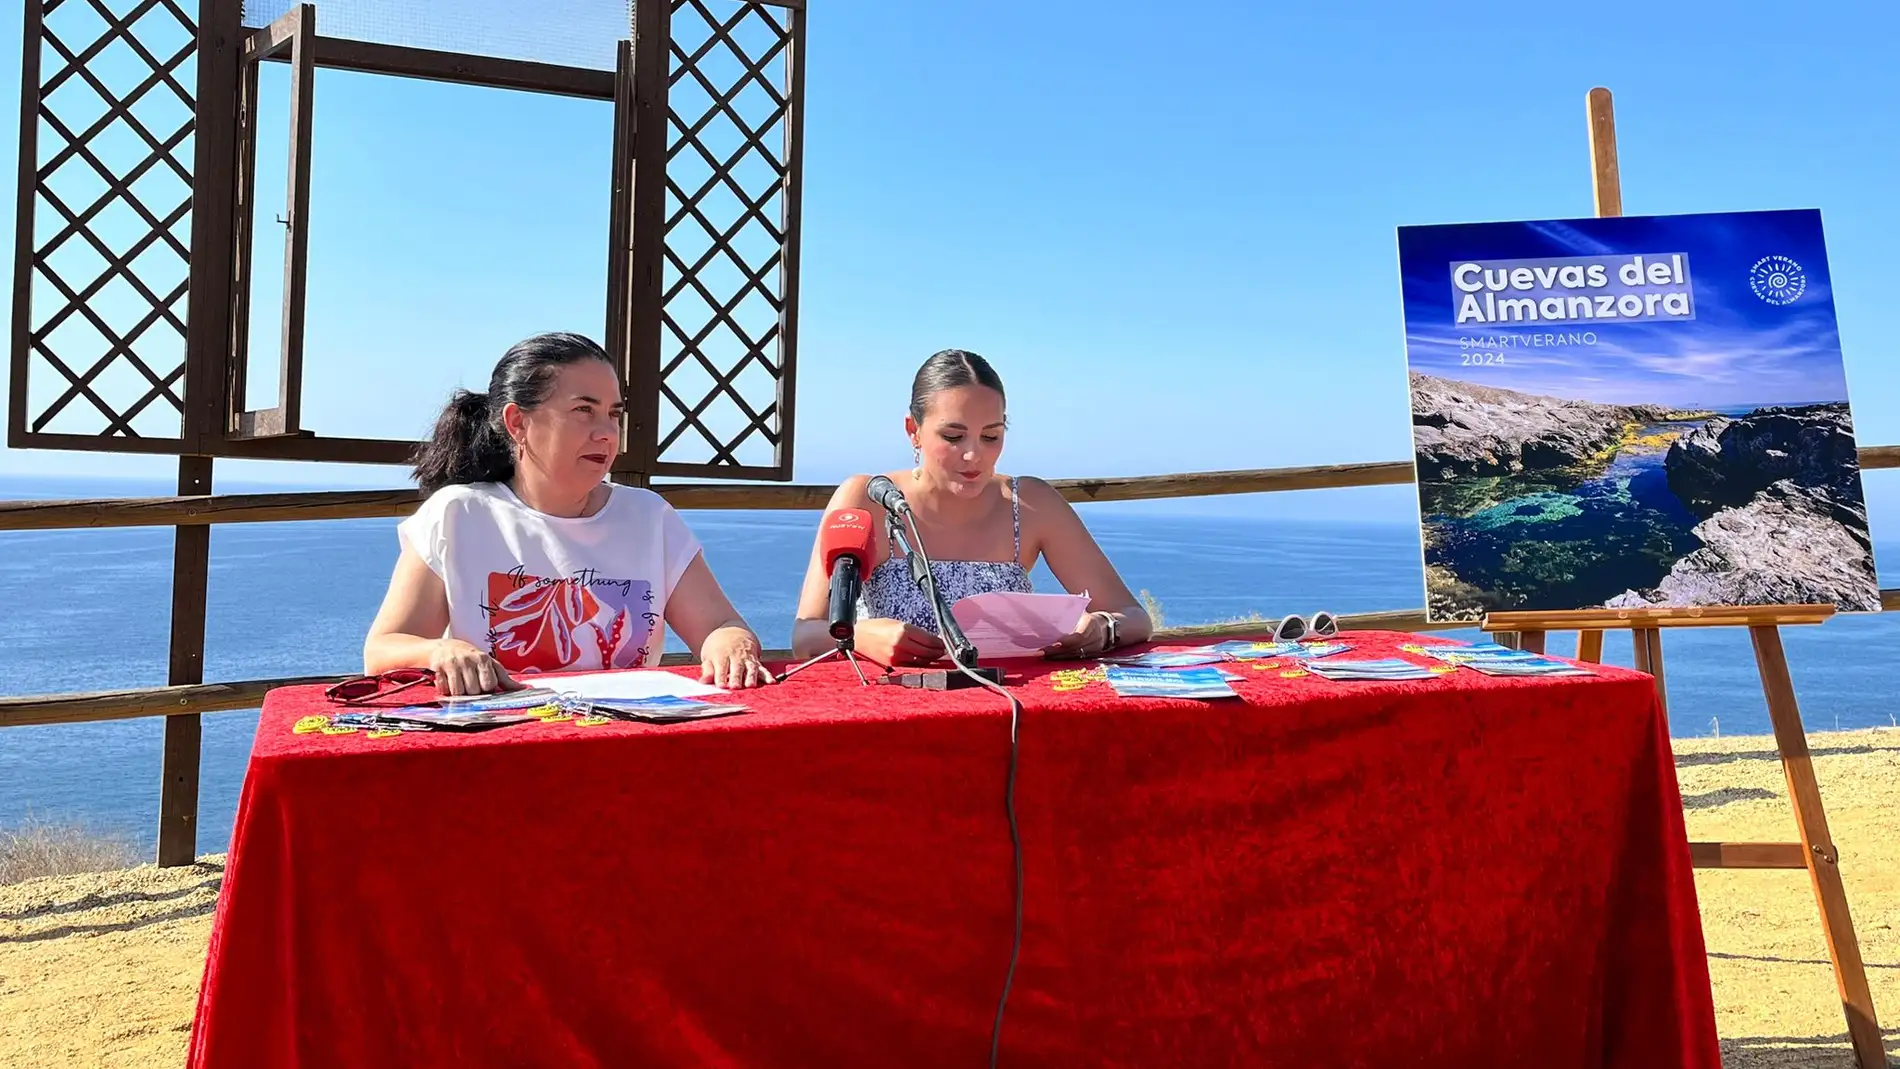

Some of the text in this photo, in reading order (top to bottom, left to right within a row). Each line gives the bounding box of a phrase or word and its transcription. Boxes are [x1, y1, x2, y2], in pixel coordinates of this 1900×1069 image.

[1454, 254, 1685, 292] Cuevas del
[1750, 255, 1802, 274] SMART VERANO
[1749, 275, 1806, 306] CUEVAS DEL ALMANZORA
[1456, 292, 1690, 323] Almanzora
[1460, 331, 1598, 350] SMARTVERANO
[1460, 352, 1505, 366] 2024
[507, 564, 632, 597] If something
[641, 612, 660, 636] for
